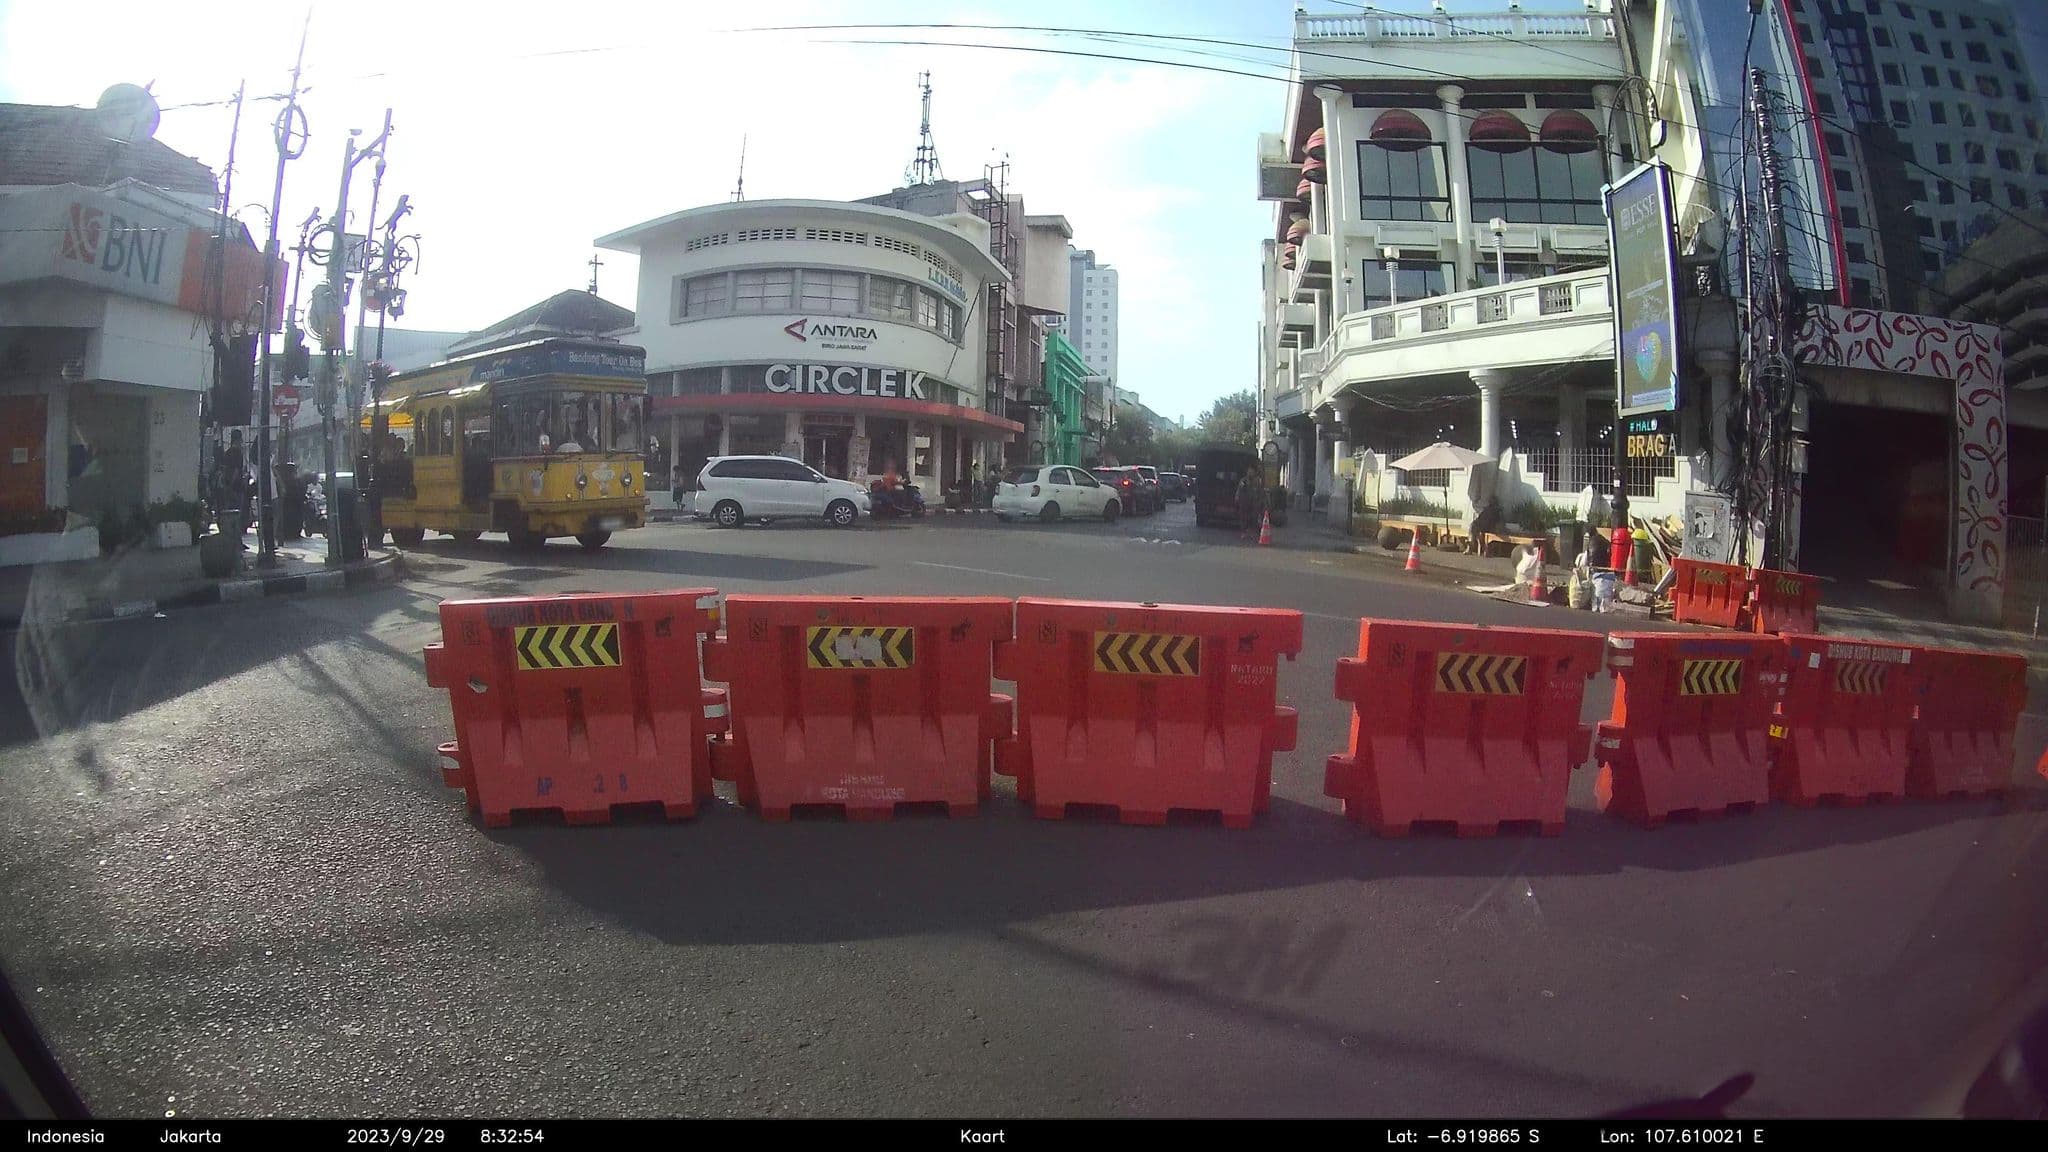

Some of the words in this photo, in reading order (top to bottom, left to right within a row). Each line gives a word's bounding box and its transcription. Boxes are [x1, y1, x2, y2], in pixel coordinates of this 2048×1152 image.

[101, 213, 168, 284] BNI
[811, 324, 877, 339] ANTARA
[765, 364, 897, 397] CIRCLE
[904, 370, 926, 399] K
